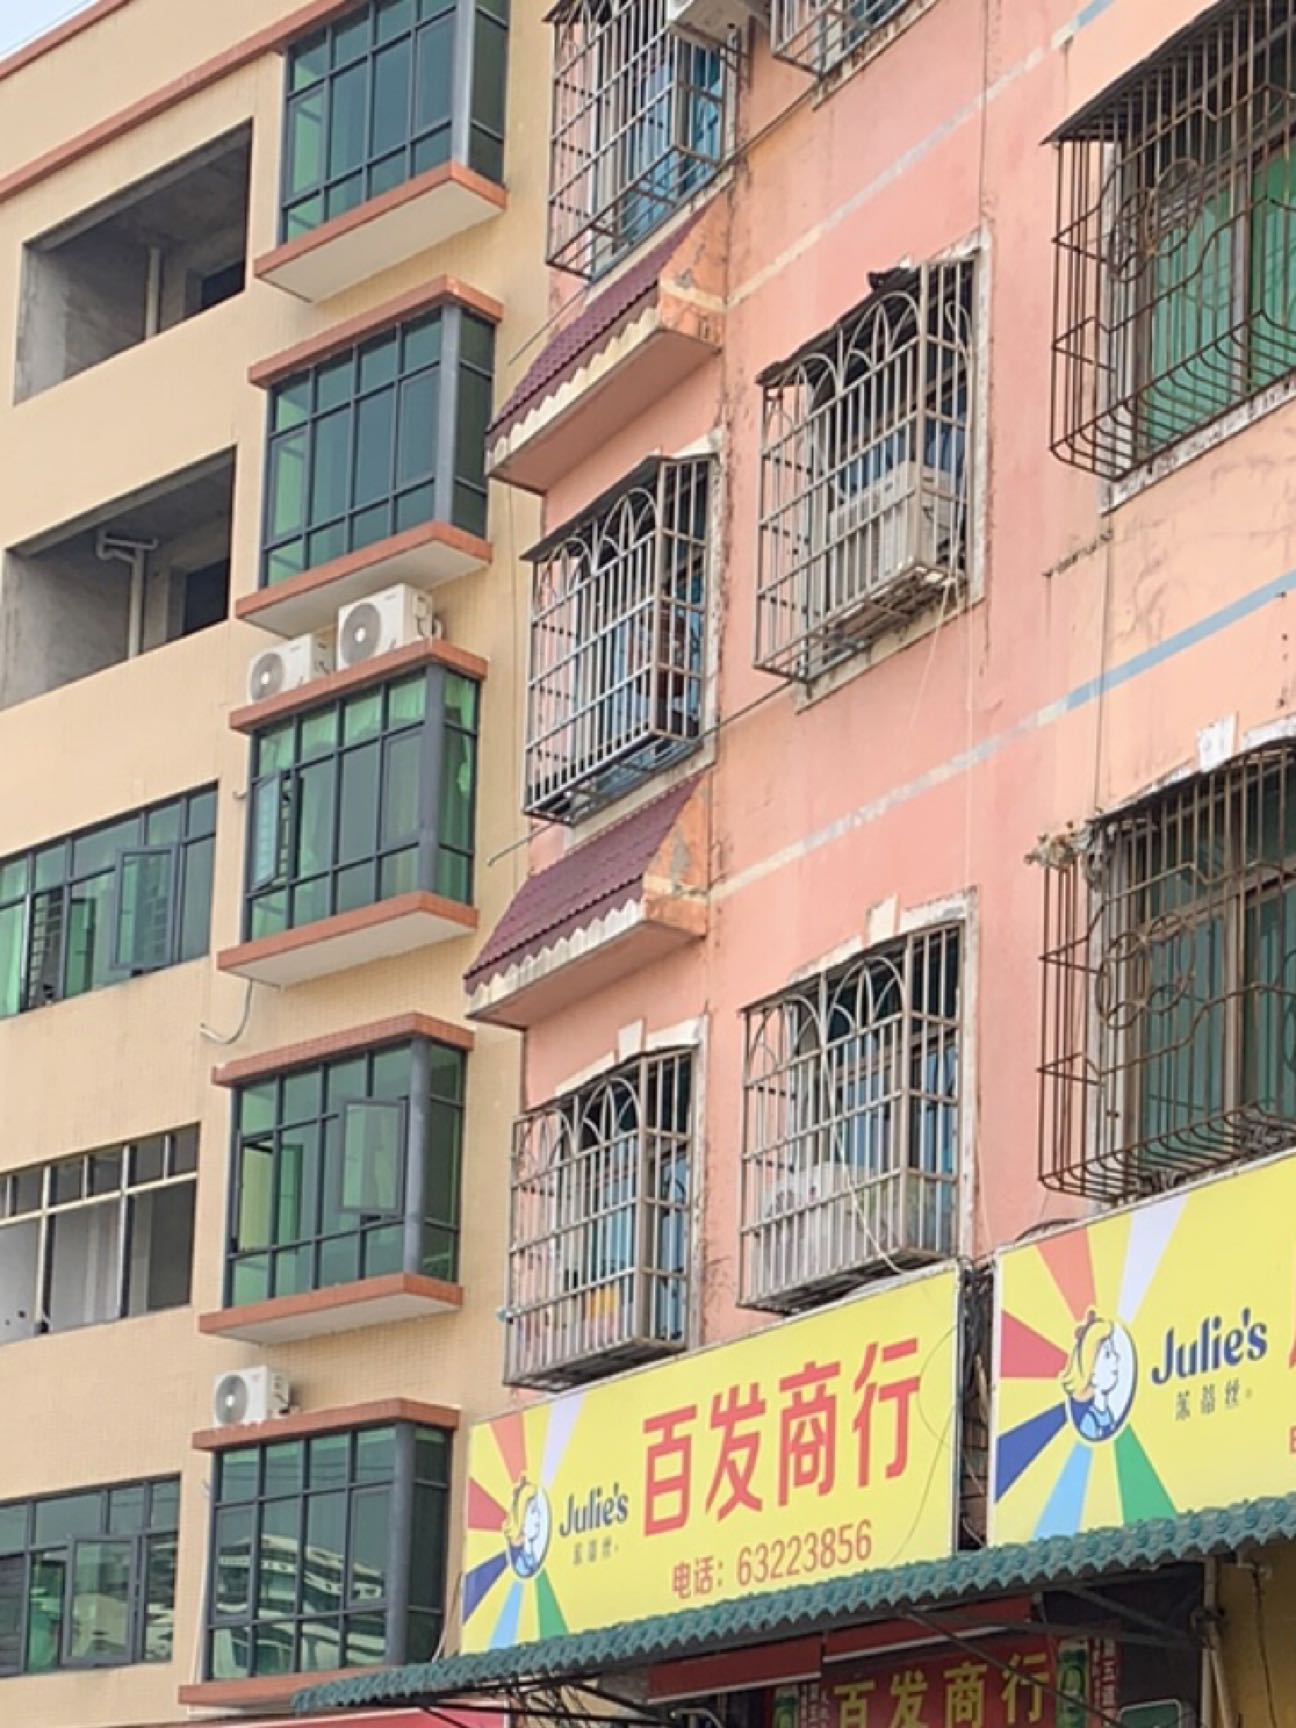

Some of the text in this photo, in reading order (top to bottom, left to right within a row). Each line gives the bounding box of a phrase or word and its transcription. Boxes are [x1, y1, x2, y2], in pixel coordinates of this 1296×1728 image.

[1151, 1306, 1268, 1386] Julie's
[643, 1337, 921, 1537] 百发商行
[559, 1482, 629, 1537] Julie's
